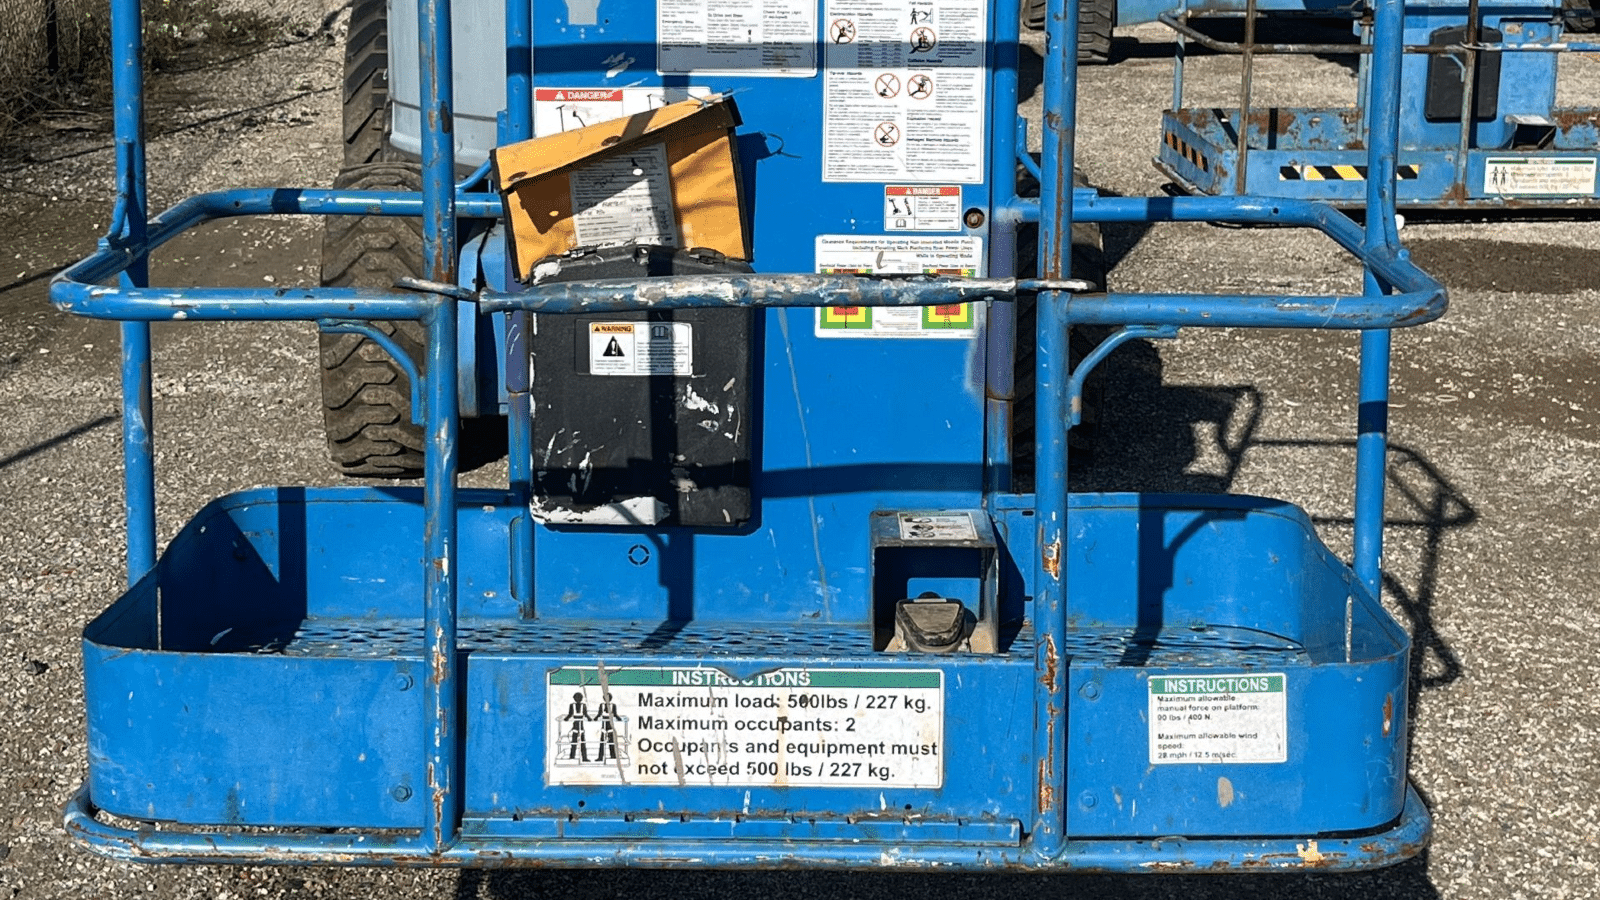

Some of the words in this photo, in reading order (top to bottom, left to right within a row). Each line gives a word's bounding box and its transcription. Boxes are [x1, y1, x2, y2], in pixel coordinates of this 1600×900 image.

[567, 91, 610, 100] DANGER
[913, 187, 940, 195] DANGER
[1164, 678, 1269, 692] INSTRUCTIONS
[638, 692, 728, 708] Maximum
[735, 693, 780, 708] load:
[787, 694, 849, 709] 500lbs
[854, 694, 860, 709] /
[866, 695, 898, 709] 227
[904, 695, 931, 713] kg.
[1198, 694, 1236, 702] allowable
[638, 715, 728, 730] Maximum
[734, 717, 838, 734] occupants:
[845, 717, 856, 732] 2
[637, 738, 739, 756] Occupans
[745, 739, 779, 753] and
[786, 739, 885, 757] equipment
[891, 741, 938, 755] must
[1169, 752, 1187, 760] mph
[638, 761, 668, 775] not
[674, 761, 740, 775] xceed
[746, 762, 779, 775] 500
[785, 762, 812, 776] lbs
[818, 762, 824, 777] /
[830, 762, 862, 777] 227
[868, 763, 895, 781] kg.
